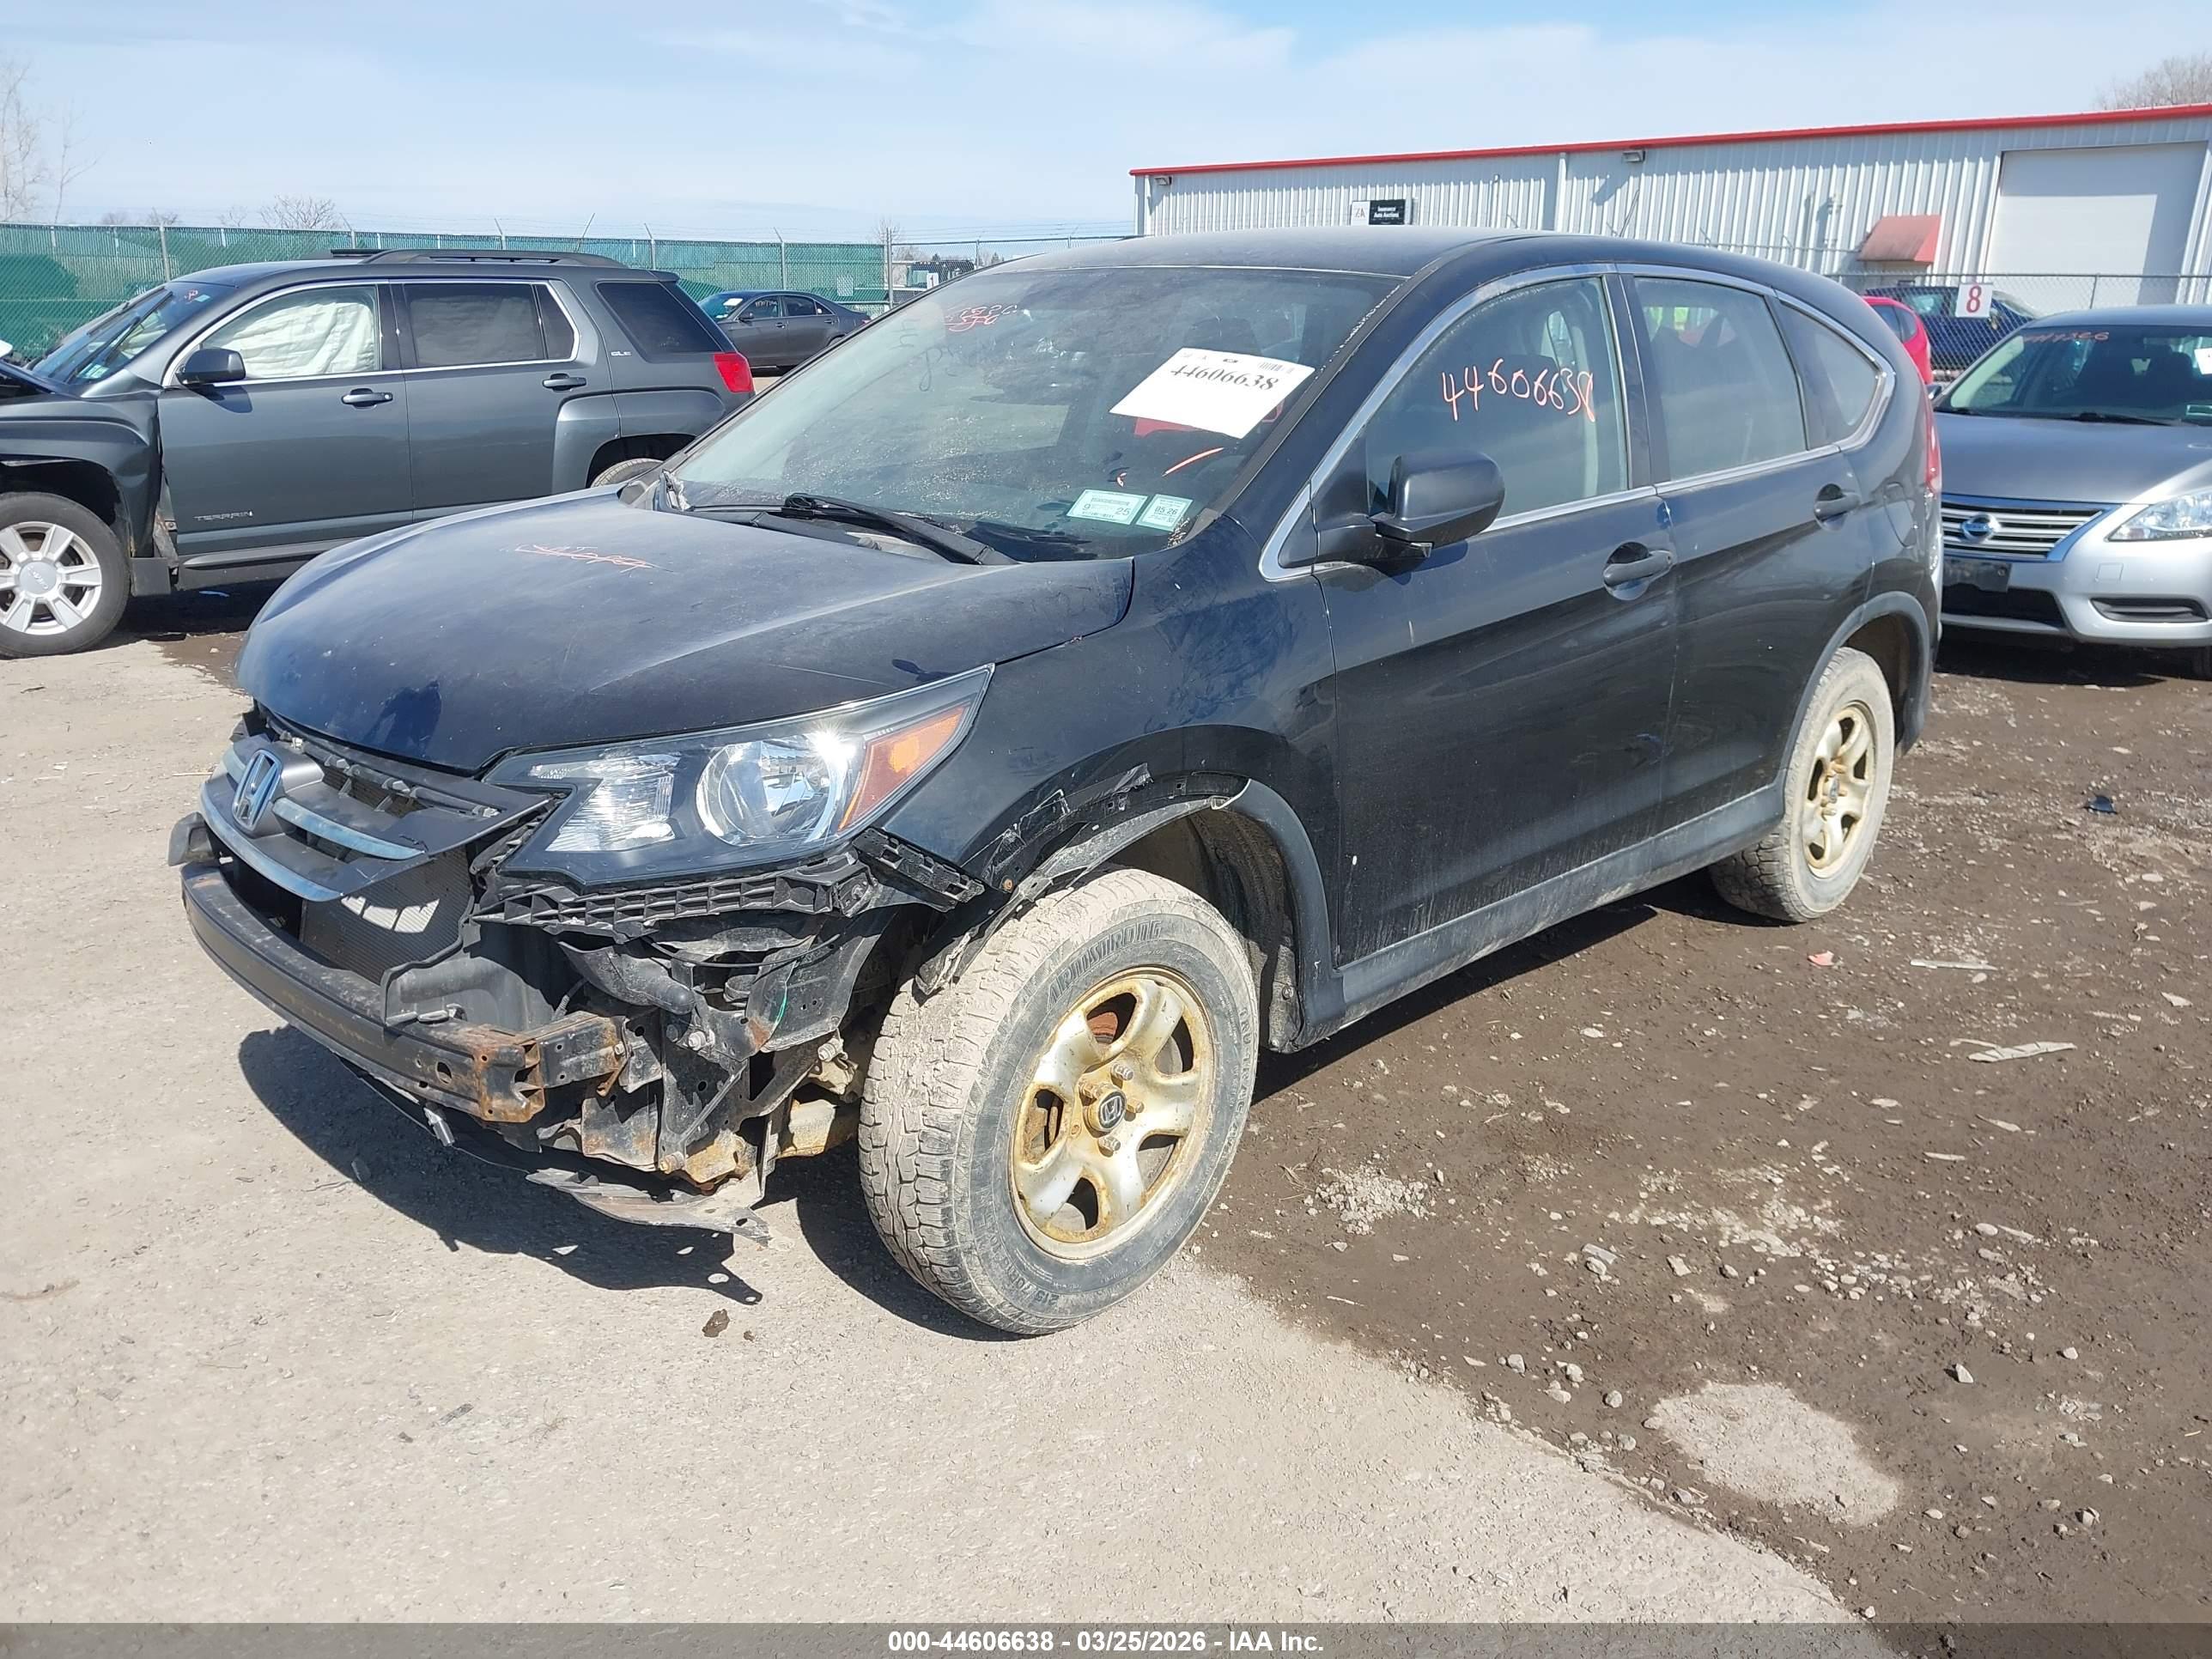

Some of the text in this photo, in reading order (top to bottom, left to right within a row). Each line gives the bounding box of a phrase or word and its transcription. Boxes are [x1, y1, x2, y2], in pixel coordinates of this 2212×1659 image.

[1966, 285, 1982, 313] 8
[1170, 364, 1279, 391] 44606638
[1442, 357, 1595, 422] 44606638
[192, 510, 252, 521] TERRAIN
[1115, 507, 1131, 516] 25
[1047, 919, 1161, 1011] ARMSTRONG
